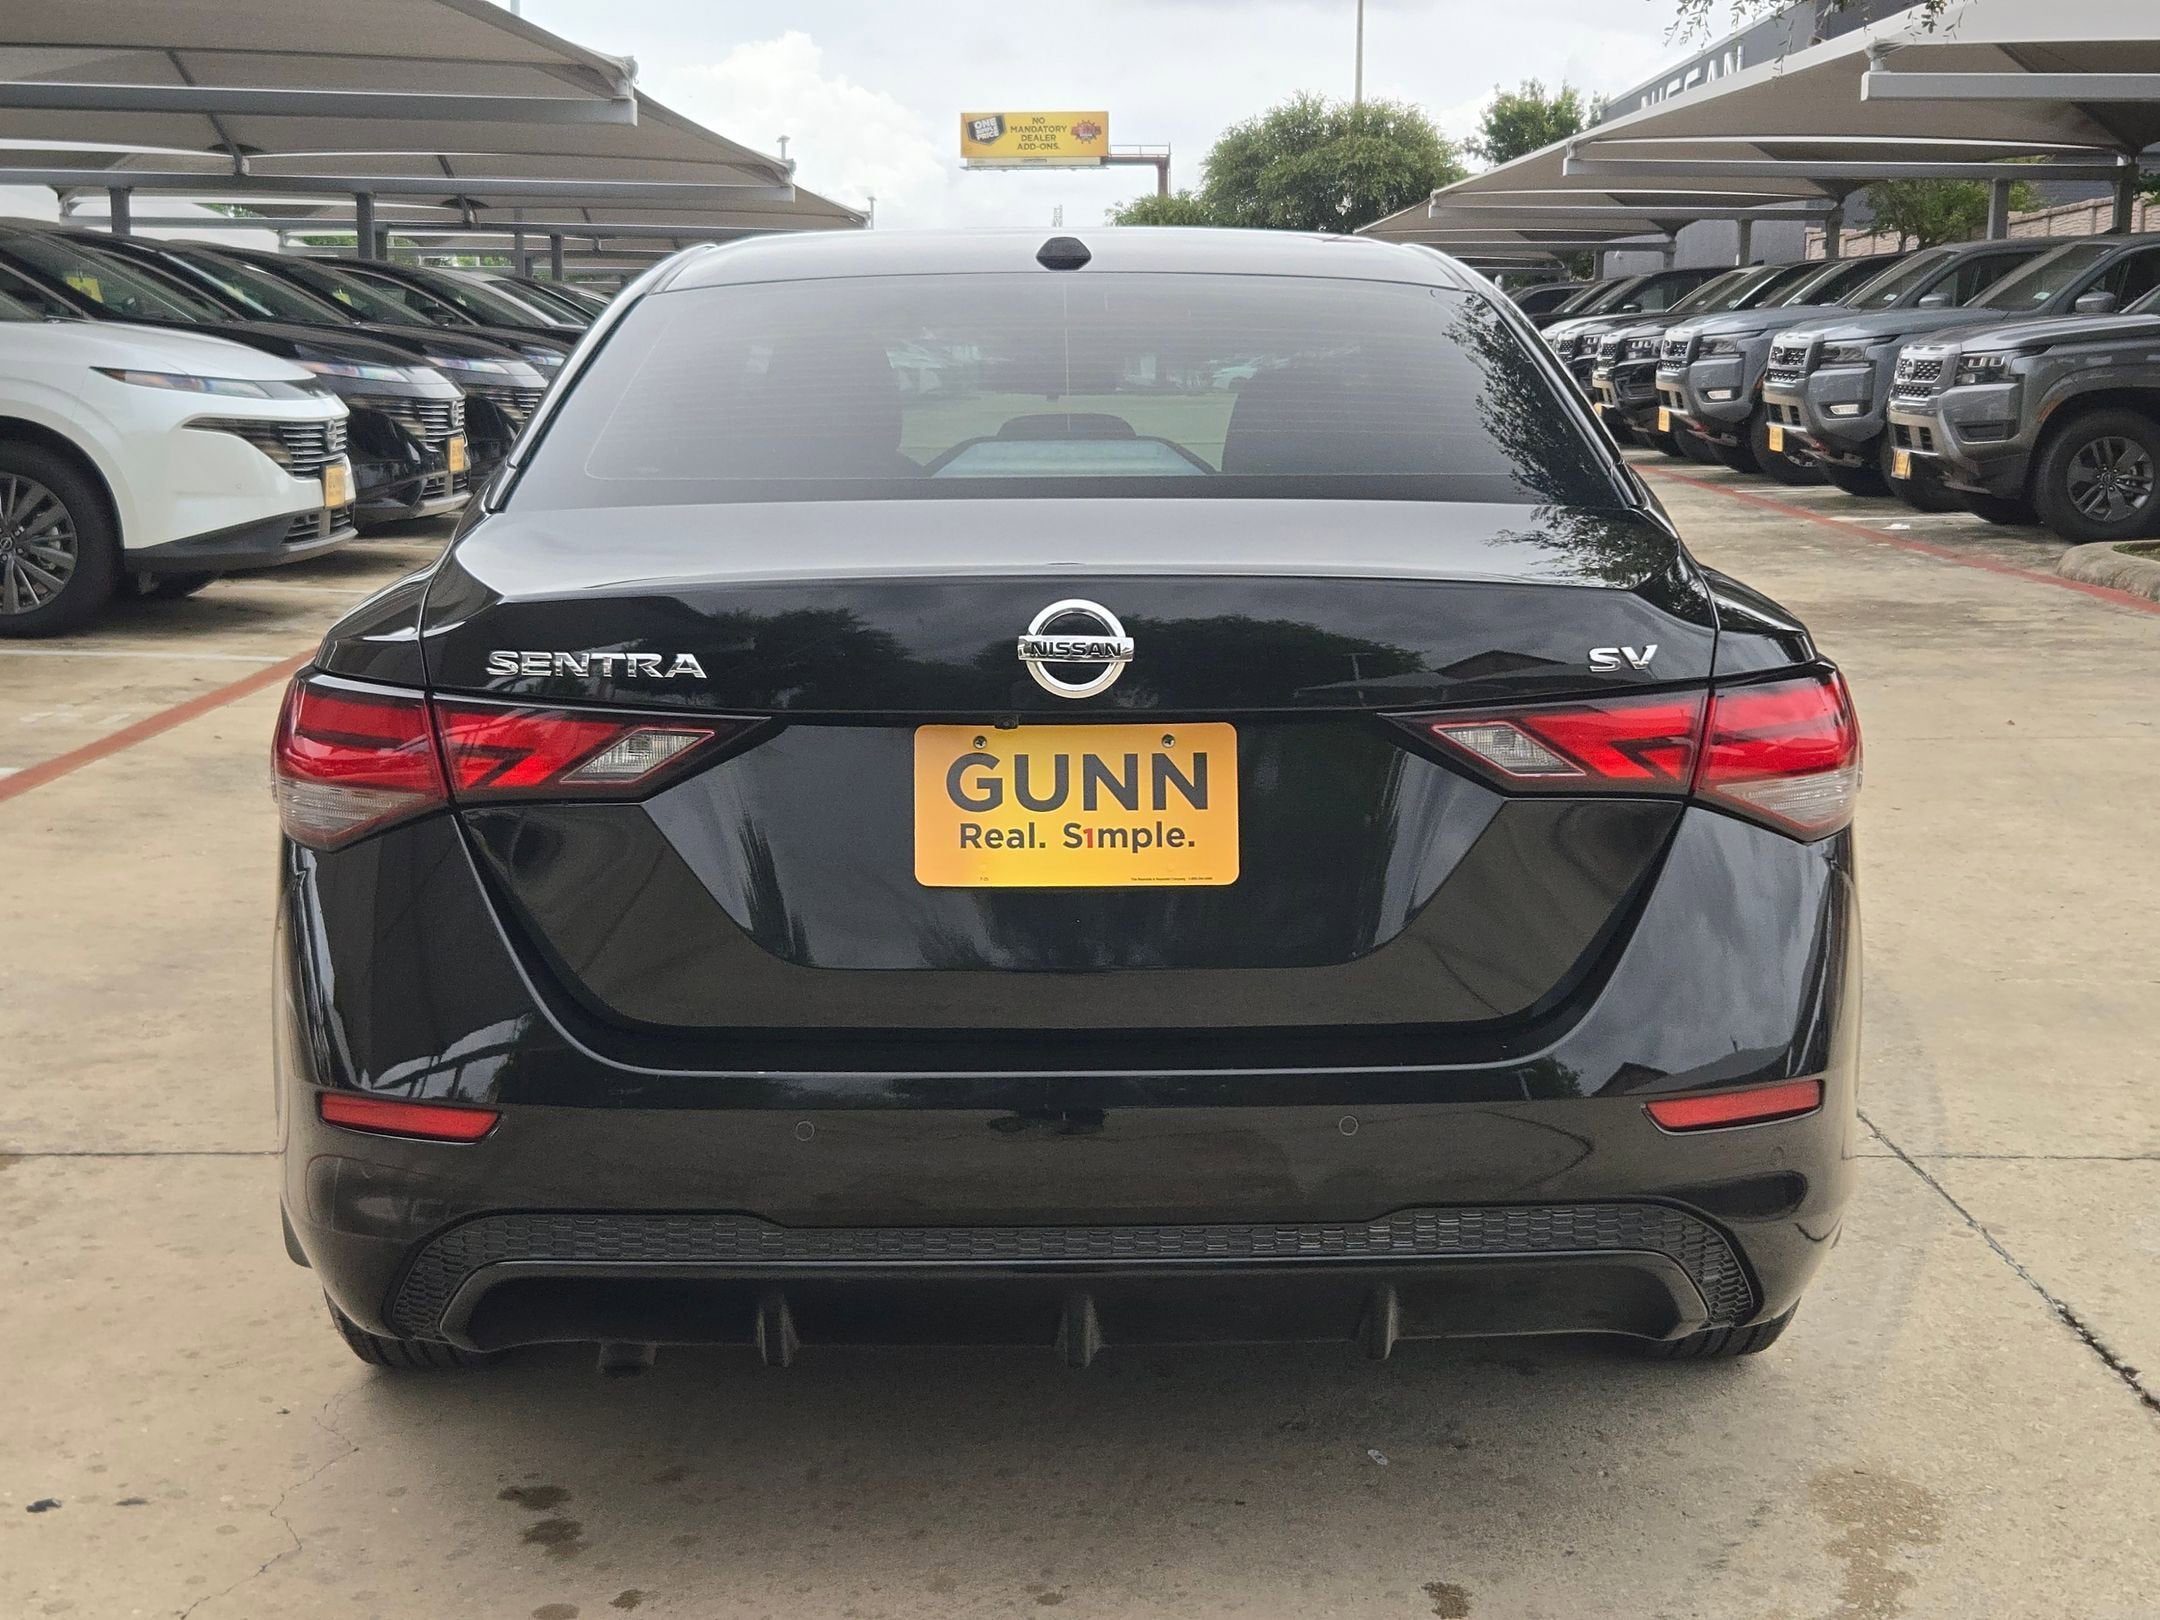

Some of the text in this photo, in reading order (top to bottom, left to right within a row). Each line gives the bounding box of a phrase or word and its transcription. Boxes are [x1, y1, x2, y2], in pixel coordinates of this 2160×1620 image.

[974, 117, 997, 129] ONE
[1032, 117, 1046, 125] NO
[1010, 125, 1067, 133] MANDATORY
[976, 131, 1000, 140] PRICE
[1021, 134, 1057, 142] DEALER
[1017, 142, 1061, 151] ADD-ONS.
[1030, 641, 1121, 657] NISSAN
[1589, 644, 1658, 672] SV
[485, 650, 707, 679] SENTRA
[946, 752, 1208, 813] GUNN
[960, 822, 1046, 849] Real.
